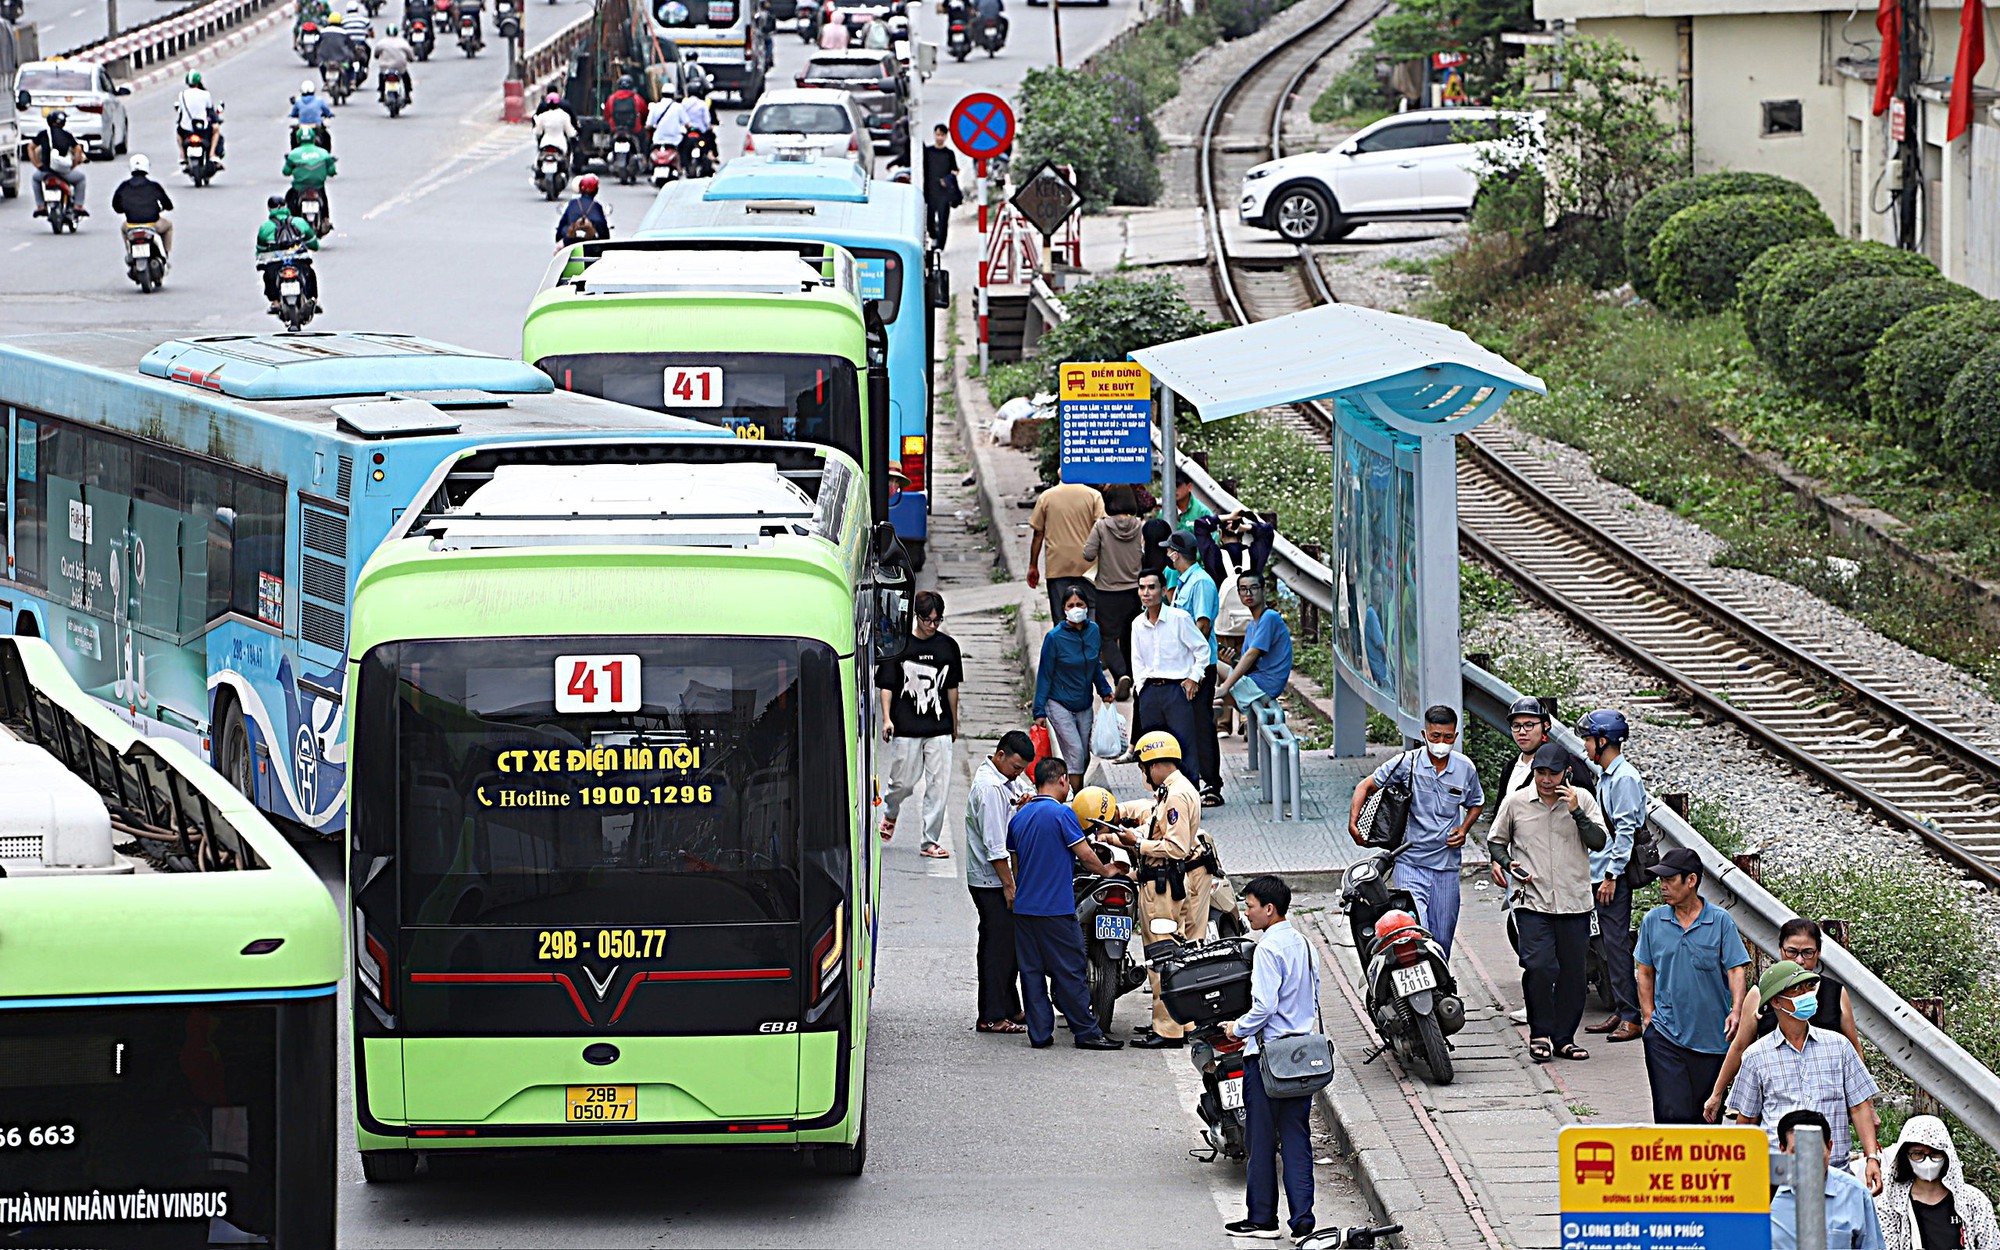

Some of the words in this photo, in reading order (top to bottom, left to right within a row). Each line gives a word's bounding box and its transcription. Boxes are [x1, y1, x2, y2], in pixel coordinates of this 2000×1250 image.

[672, 372, 711, 401] 41
[1098, 383, 1110, 391] XE
[1112, 380, 1134, 391] BUÝT
[567, 661, 623, 703] 41
[1141, 741, 1165, 753] CSGT
[497, 750, 529, 773] CT
[532, 749, 561, 772] XE
[566, 743, 618, 777] ĐIỆN
[624, 742, 653, 770] HÀ
[659, 743, 700, 776] NỘI
[499, 788, 571, 807] Hotline
[578, 785, 712, 806] 1900.1296
[538, 930, 577, 959] 29B
[598, 929, 667, 959] 050.77
[1397, 965, 1427, 982] 24-FA
[1402, 976, 1430, 994] 2016
[585, 1087, 617, 1103] 29B
[573, 1104, 629, 1120] 050.77
[29, 1125, 75, 1146] 663
[1631, 1137, 1683, 1161] ĐIỂM
[1690, 1140, 1746, 1161] DỪNG
[1649, 1173, 1675, 1190] XE
[1681, 1168, 1732, 1190] BUÝT
[0, 1192, 60, 1223] THÀNH
[64, 1190, 116, 1221] NHÂN
[119, 1188, 159, 1219] VIÊN
[162, 1191, 228, 1219] VINBUS
[1582, 1224, 1612, 1237] LONG
[1613, 1221, 1640, 1237] BIÊN
[1649, 1224, 1672, 1240] VẠN
[1674, 1221, 1705, 1238] PHÚC
